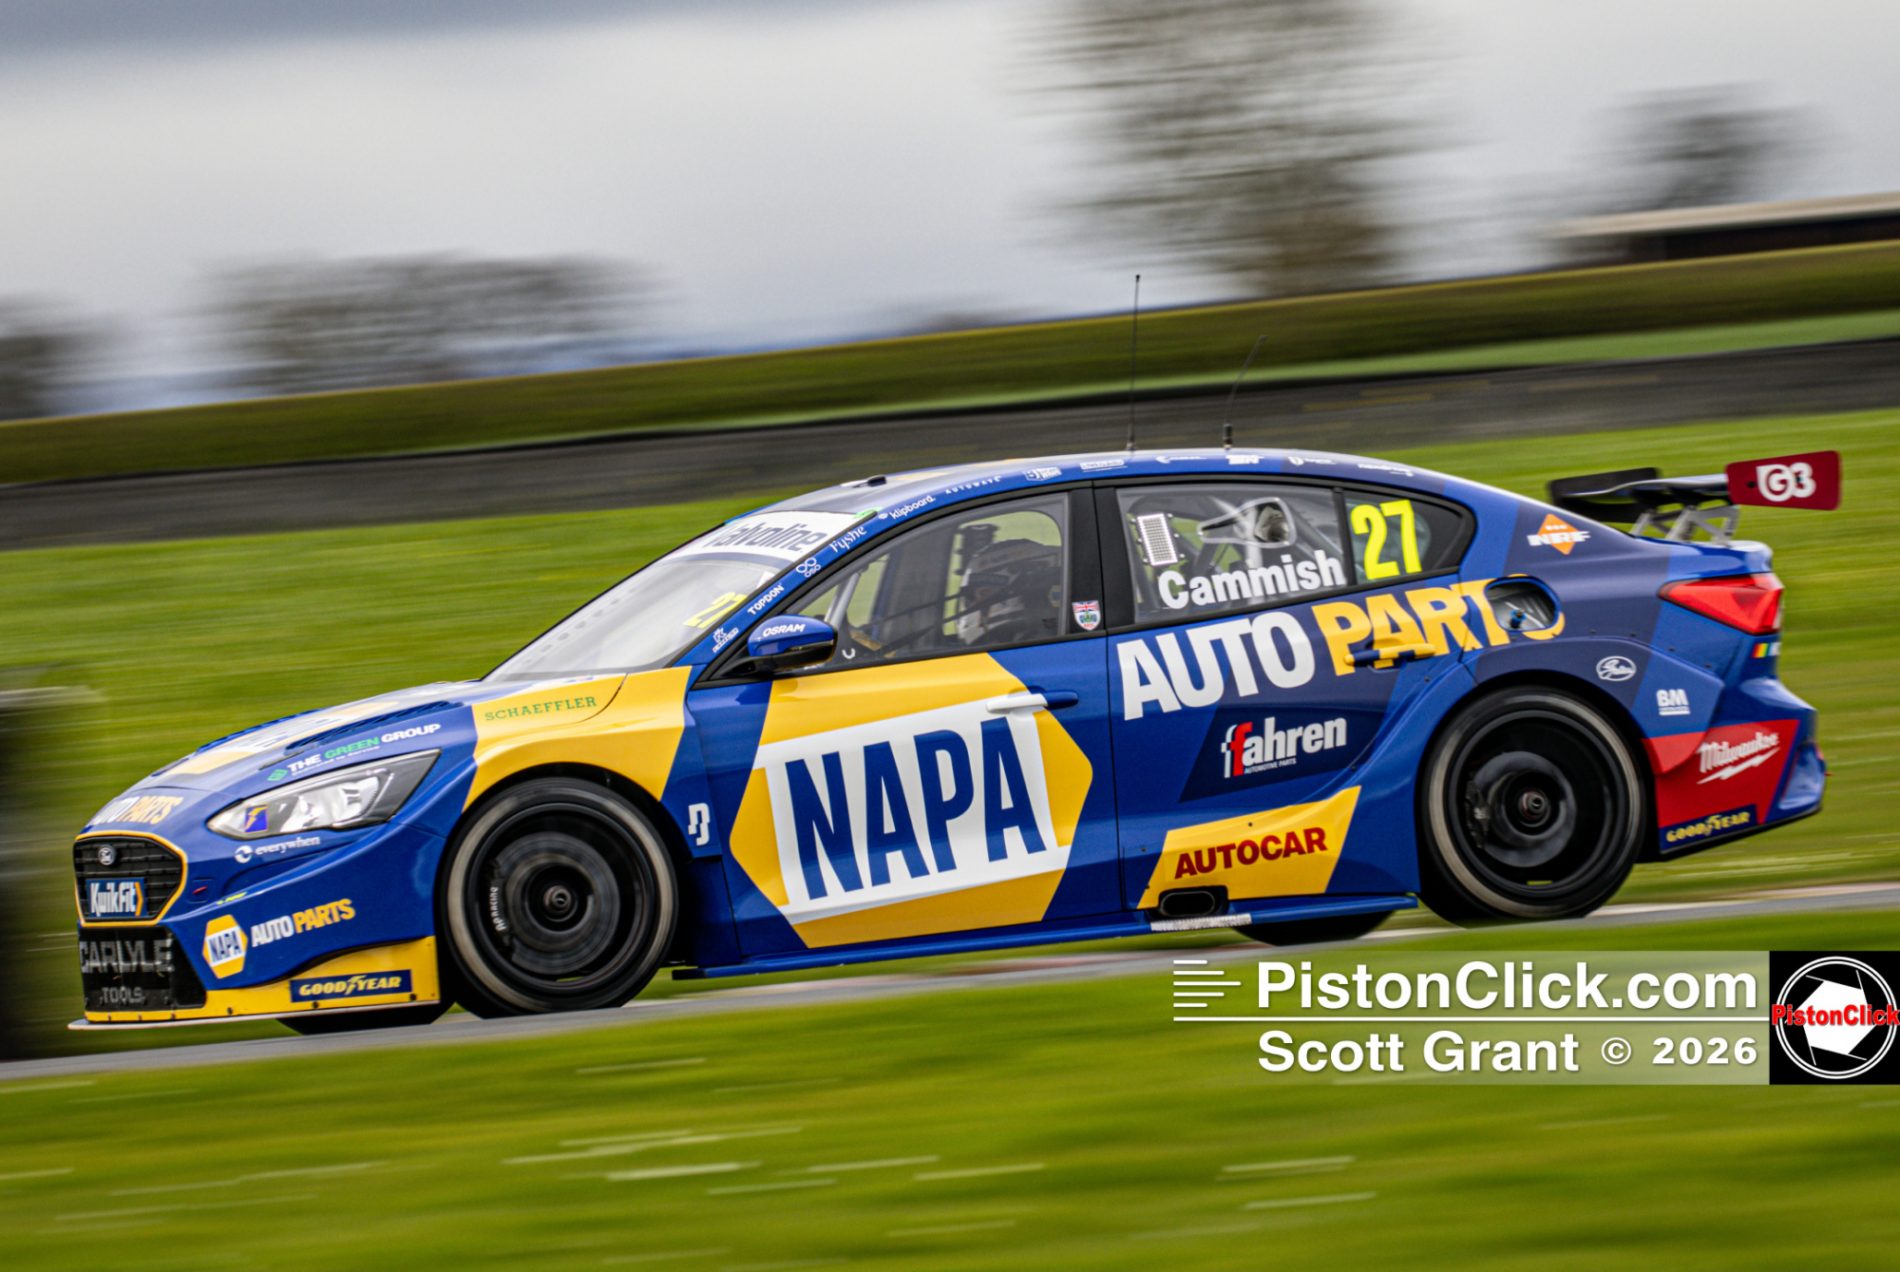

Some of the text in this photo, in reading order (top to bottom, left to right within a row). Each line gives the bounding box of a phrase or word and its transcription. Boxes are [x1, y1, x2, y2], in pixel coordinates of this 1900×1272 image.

[1756, 462, 1816, 502] G3
[1349, 499, 1422, 580] 27
[747, 583, 785, 616] TOPDON
[1157, 549, 1347, 610] Cammish
[762, 623, 806, 638] OSRAM
[1116, 611, 1316, 721] AUTO
[484, 695, 598, 721] SCHAEFFLER
[1656, 688, 1689, 707] BM
[287, 753, 322, 773] THE
[324, 736, 381, 760] GREEN
[381, 722, 442, 744] GROUP
[1221, 716, 1347, 778] fahren
[1696, 731, 1780, 774] Milwaukee
[784, 716, 1047, 900] NAPA
[1173, 826, 1328, 880] AUTOCAR
[207, 898, 356, 963] NAPA AUTO PARTS
[79, 938, 175, 974] CARLYLE
[101, 985, 144, 1004] TOOLS
